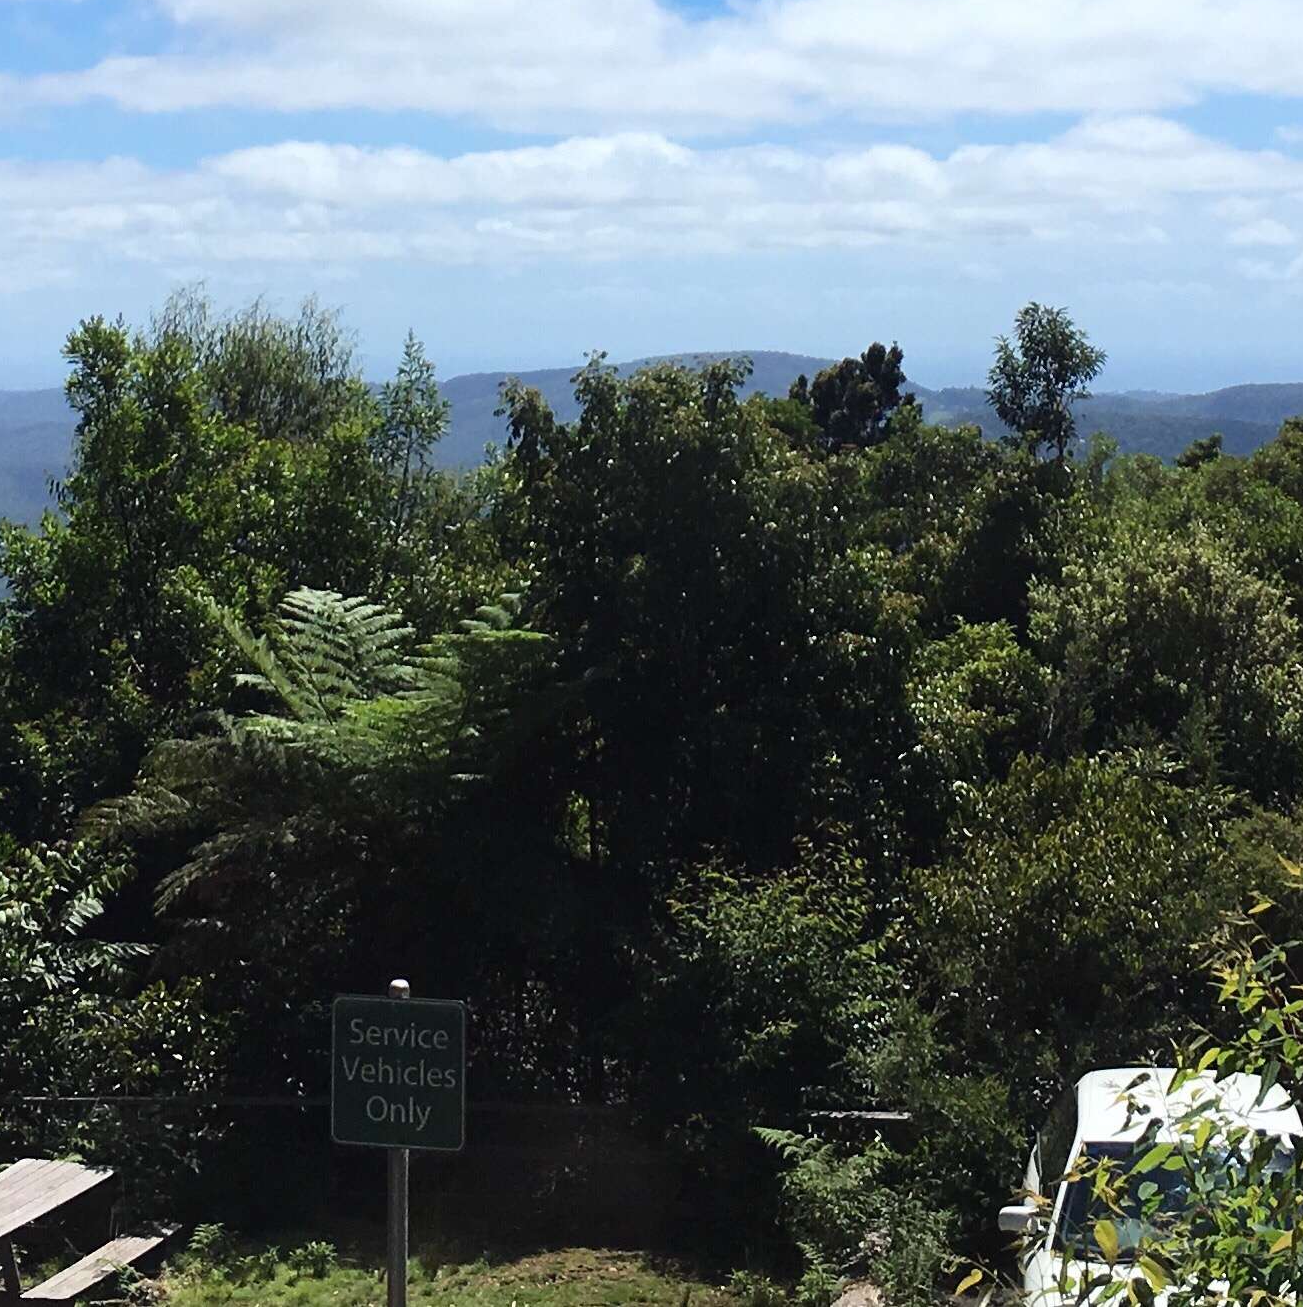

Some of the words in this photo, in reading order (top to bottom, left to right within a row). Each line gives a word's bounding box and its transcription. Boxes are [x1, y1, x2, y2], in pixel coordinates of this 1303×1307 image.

[349, 1018, 450, 1049] Service
[341, 1056, 457, 1088] Vehicles
[366, 1095, 432, 1131] Only
